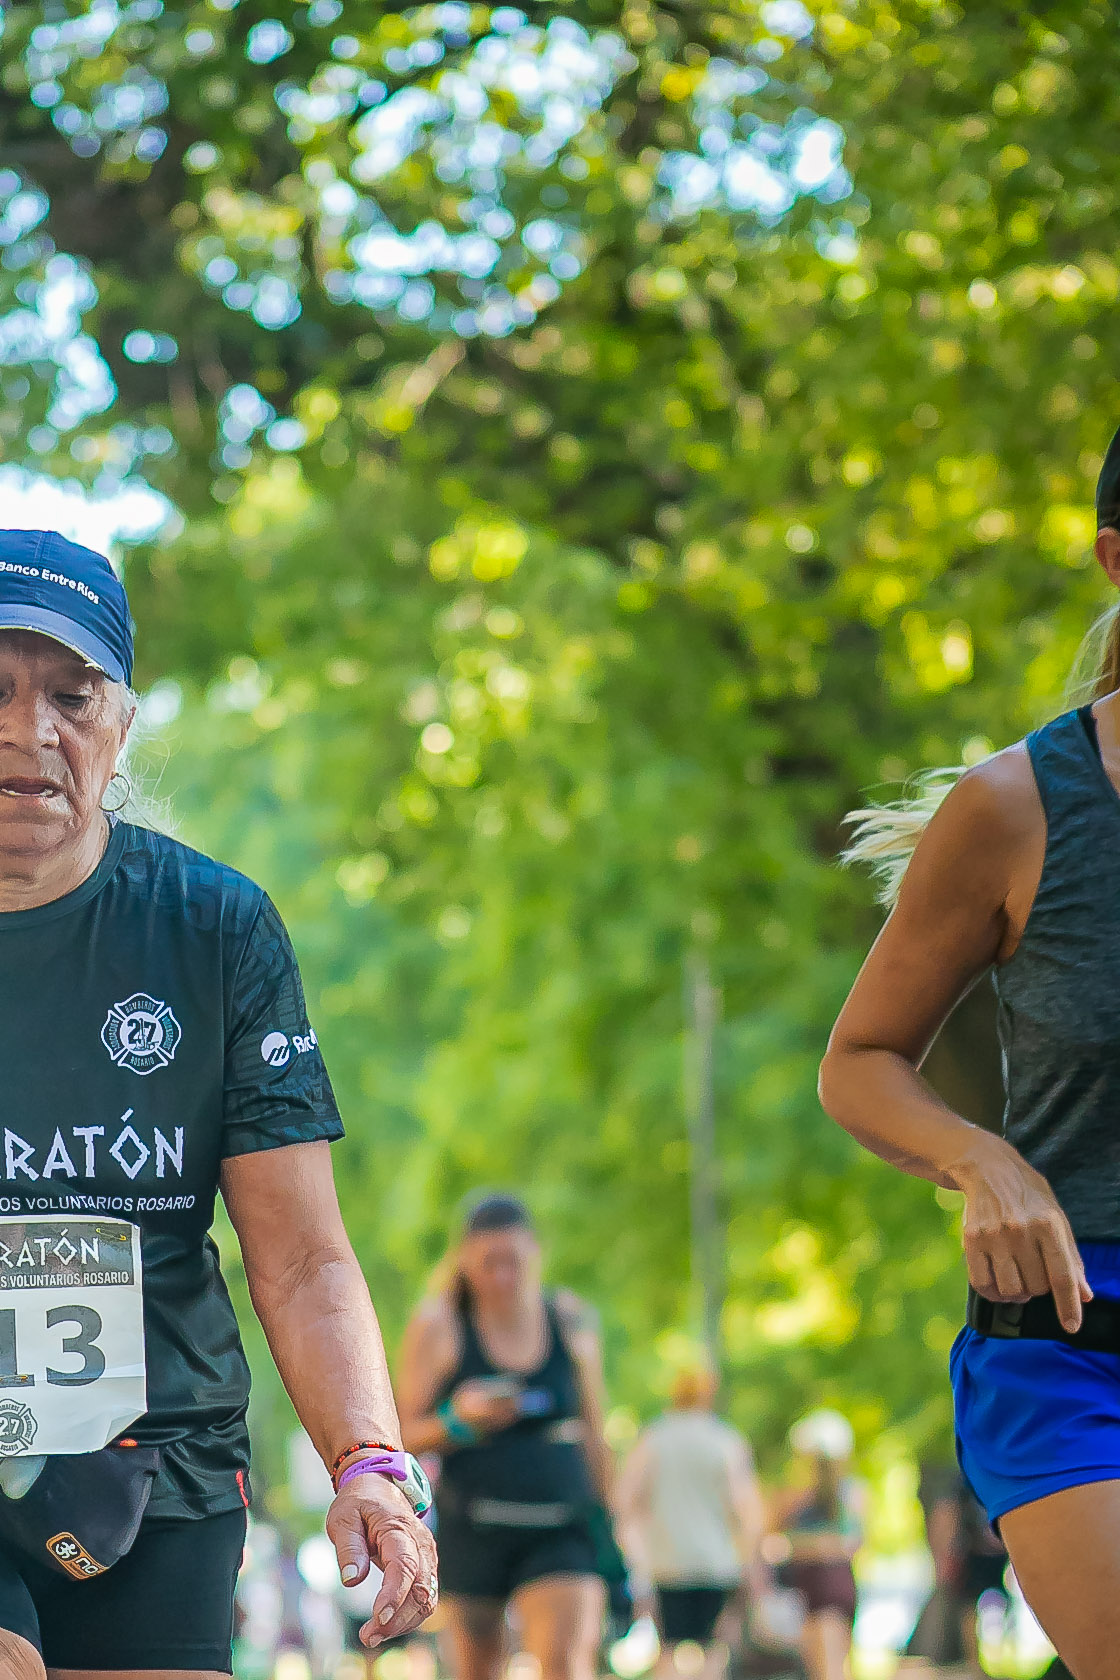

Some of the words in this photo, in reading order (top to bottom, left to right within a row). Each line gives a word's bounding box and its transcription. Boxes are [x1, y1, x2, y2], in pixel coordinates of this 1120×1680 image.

[41, 569, 77, 590] Entre
[127, 1018, 157, 1045] 27
[25, 1195, 133, 1211] VOLUNTARIOS
[136, 1195, 196, 1212] ROSARIO
[9, 1272, 81, 1287] VOLUNTARIOS
[83, 1271, 130, 1284] ROSARIO
